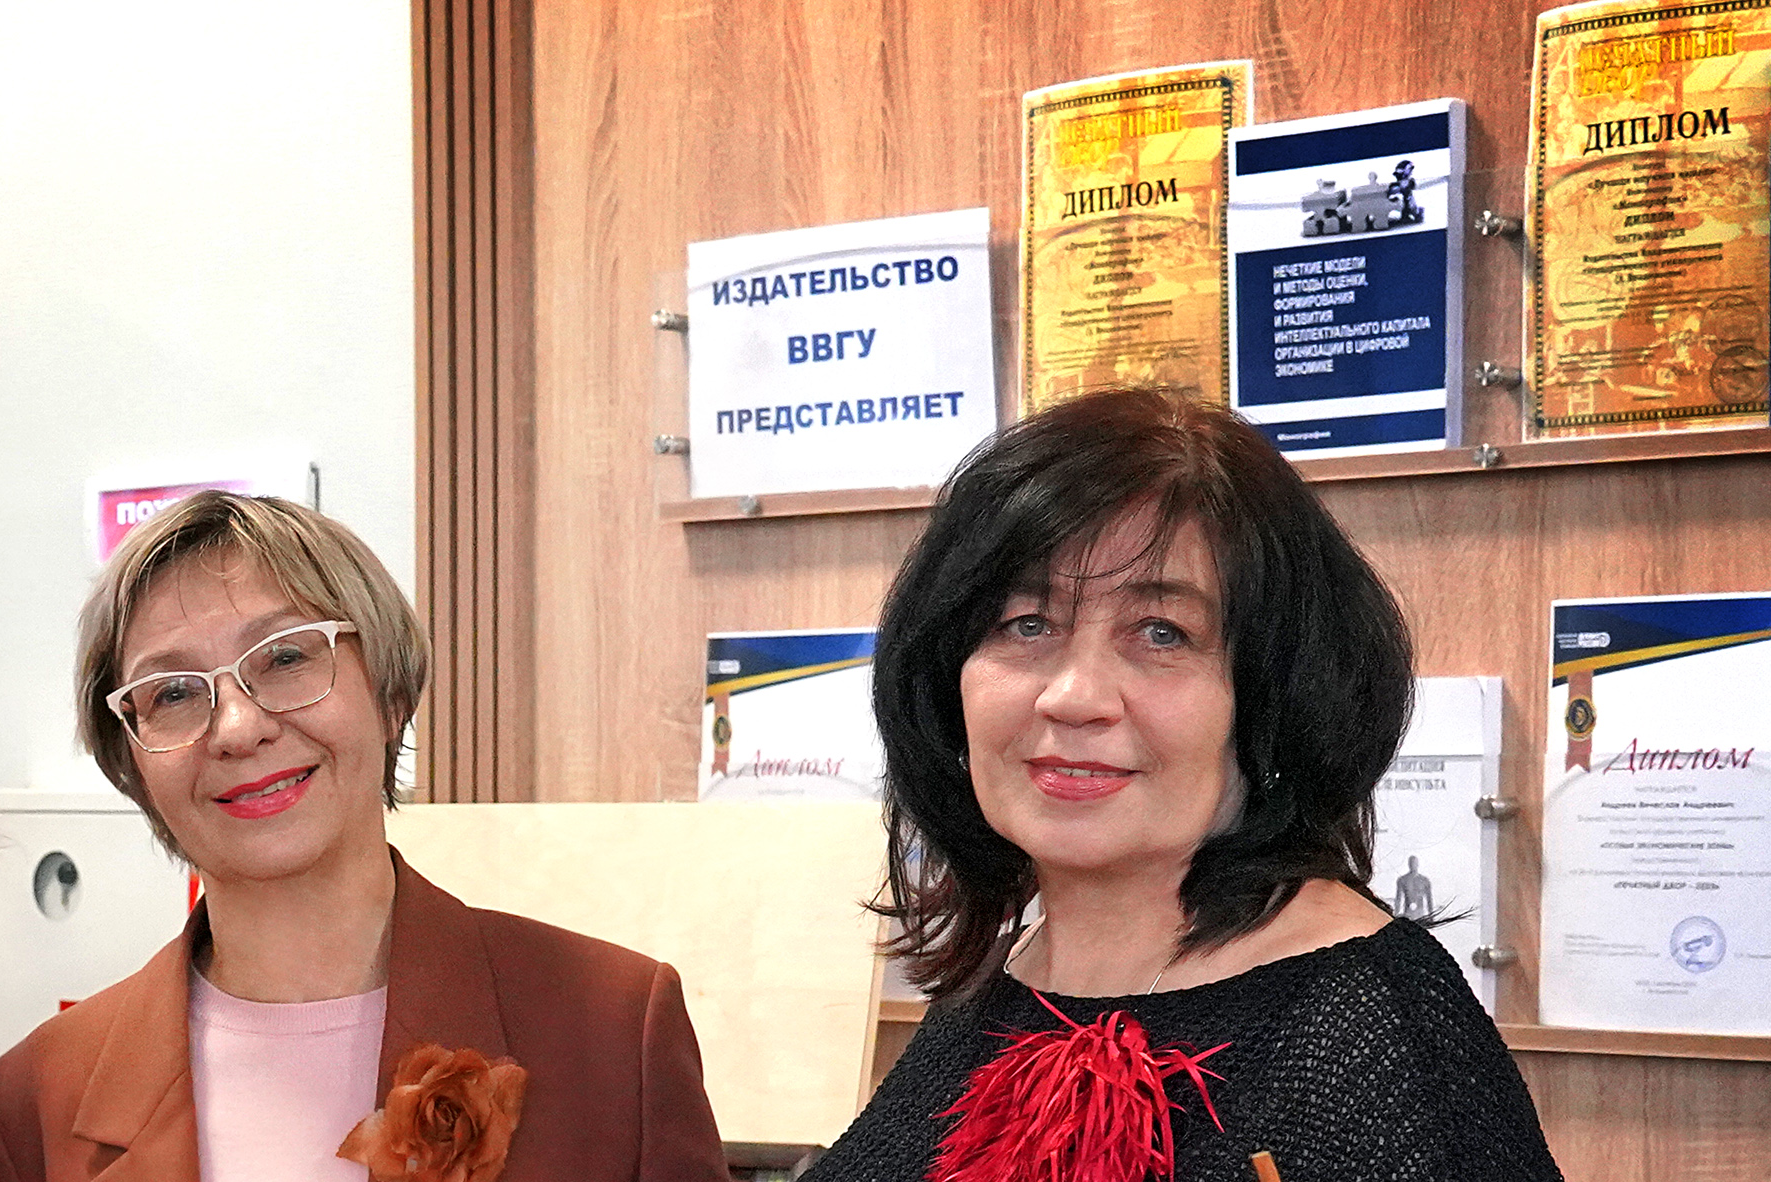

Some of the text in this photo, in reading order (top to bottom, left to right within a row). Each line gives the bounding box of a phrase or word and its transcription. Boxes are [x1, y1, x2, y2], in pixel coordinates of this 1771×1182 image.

[1583, 107, 1732, 156] ДИПЛОМ
[1061, 178, 1179, 220] ДИПЛОМ
[713, 256, 959, 306] ИЗДАТЕЛЬСТВО
[1273, 256, 1366, 278] НЕЧЕТКИЕ МОДЕЛИ
[1273, 273, 1369, 295] И МЕТОДЫ ОЦЕНКИ,
[1273, 291, 1355, 311] ФОРМИРОВАНИЯ
[1274, 310, 1334, 328] И РАЗВИТИЯ
[1274, 316, 1431, 344] ИНТЕЛЛЕКТУАЛЬНОГО КАПИТАЛА
[788, 328, 876, 364] ВВГУ
[1274, 333, 1410, 361] ОРГАНИЗАЦИИ В ЦИФРОВОЙ
[1275, 359, 1334, 377] ЭКОНОМИКЕ
[716, 391, 965, 434] ПРЕДСТАВЛЯЕТ
[1603, 738, 1755, 775] Диплом
